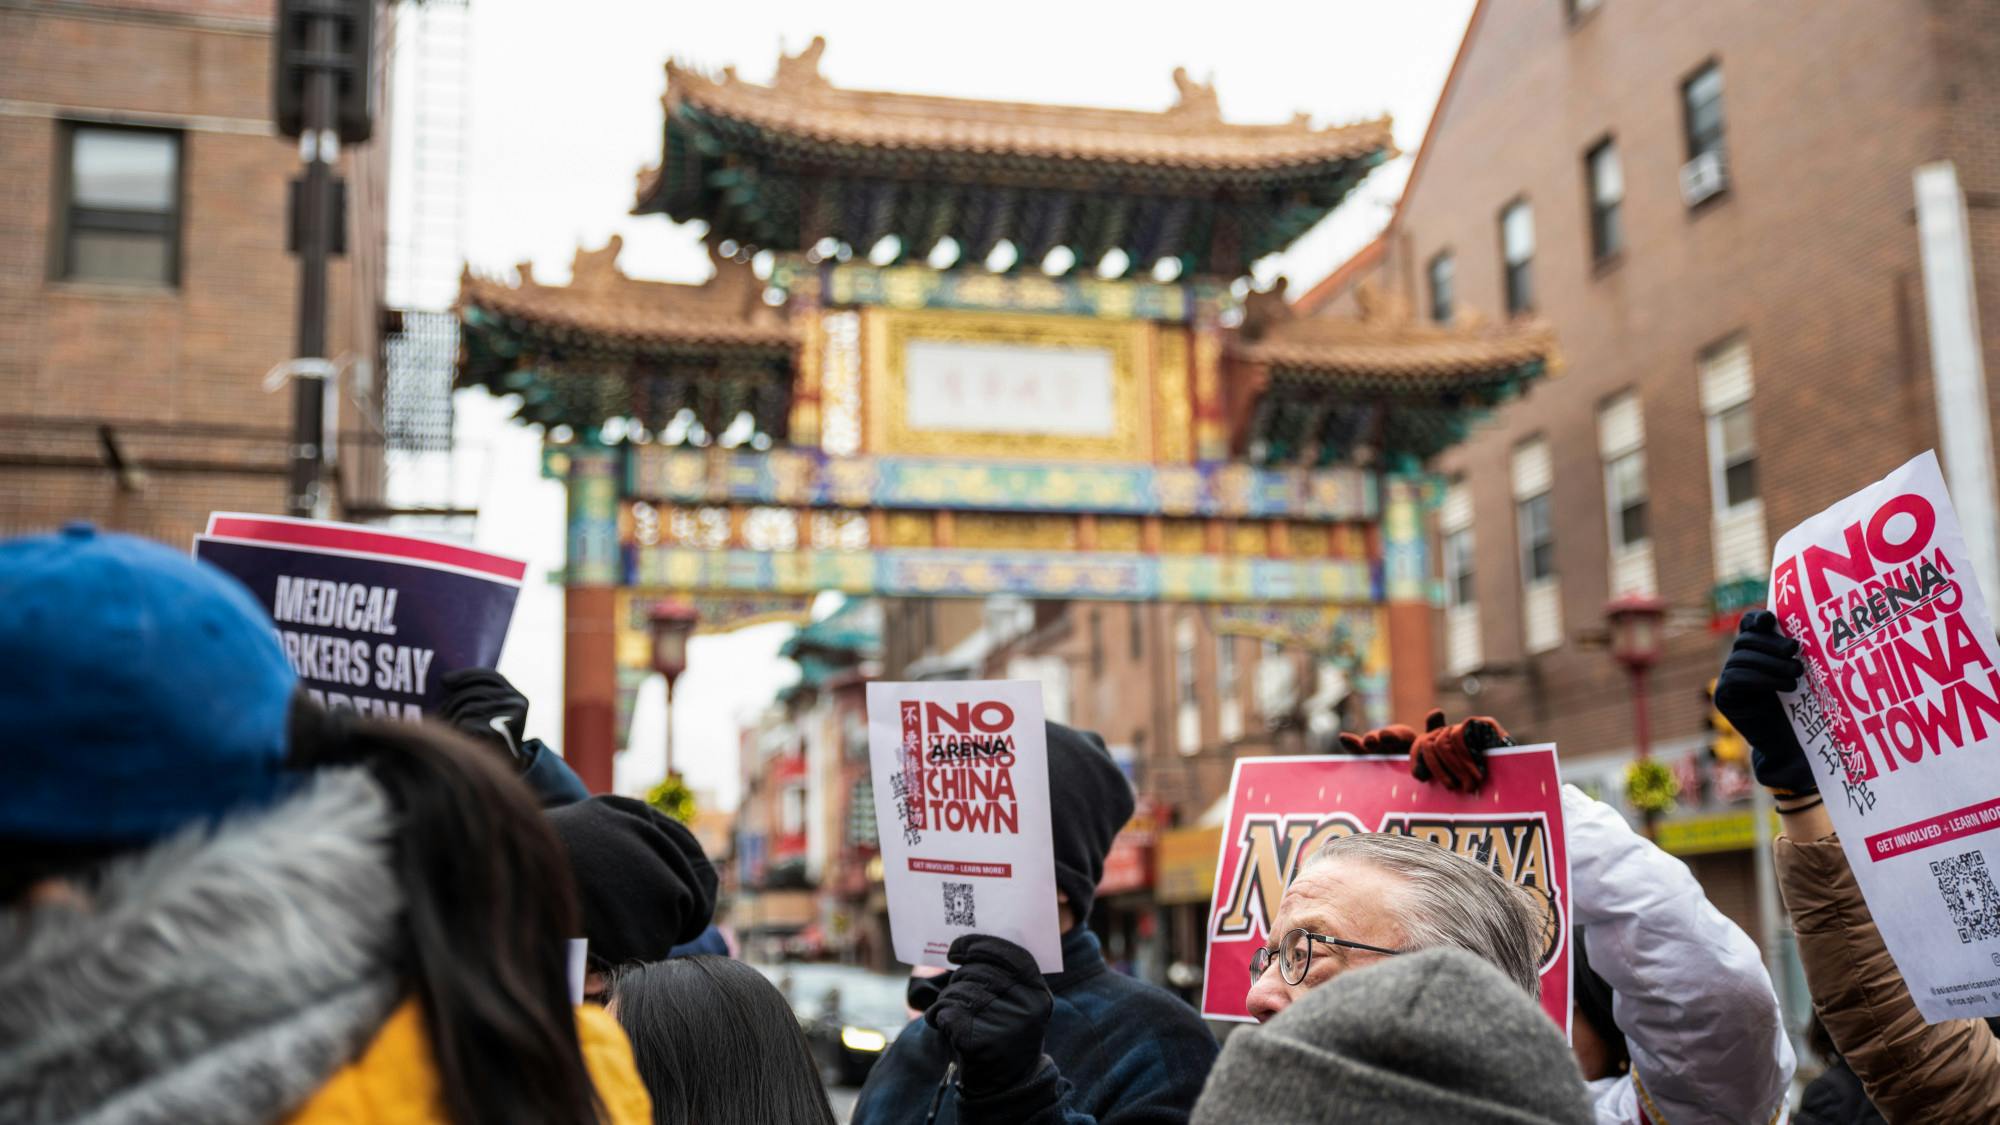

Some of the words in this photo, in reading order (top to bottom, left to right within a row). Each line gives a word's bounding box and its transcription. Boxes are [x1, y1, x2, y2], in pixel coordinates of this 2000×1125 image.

[1802, 494, 1936, 606] NO
[274, 575, 398, 636] MEDICAL
[1832, 562, 1949, 649] ARENA
[272, 628, 370, 687] RKERS
[375, 643, 434, 695] SAY
[1841, 611, 1993, 715] CHINA
[925, 701, 1014, 734] NO
[931, 738, 1008, 759] ARENA
[1861, 668, 2000, 772] TOWN
[926, 768, 1016, 801] CHINA
[929, 800, 1018, 834] TOWN
[1876, 837, 1894, 853] GET
[1895, 824, 1942, 848] INVOLVED
[1949, 812, 1981, 832] LEARN
[1216, 818, 1362, 936] N
